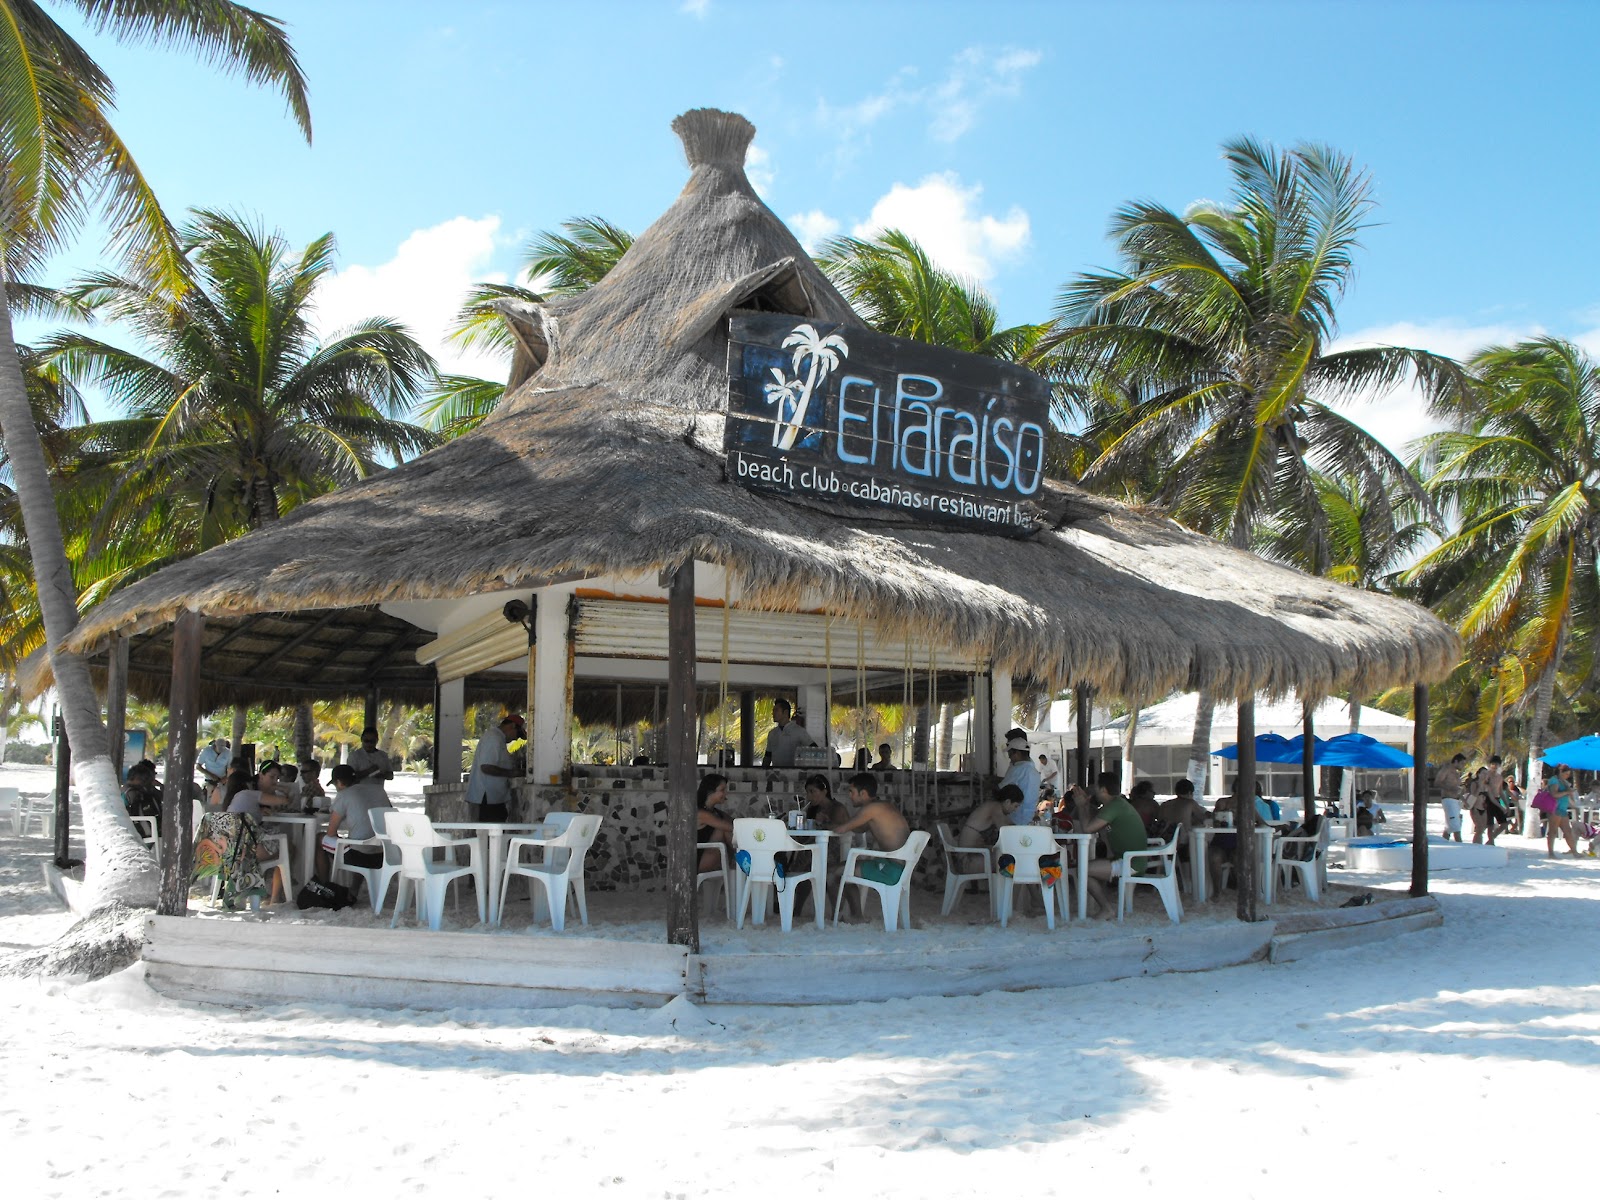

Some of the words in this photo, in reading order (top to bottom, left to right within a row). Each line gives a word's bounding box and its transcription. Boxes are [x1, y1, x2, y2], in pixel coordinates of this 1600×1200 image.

[836, 375, 881, 465] El
[892, 373, 1044, 495] Paraíso
[737, 452, 794, 489] beach
[800, 466, 839, 493] club
[850, 477, 921, 508] cabañas
[930, 495, 1011, 524] restaurant
